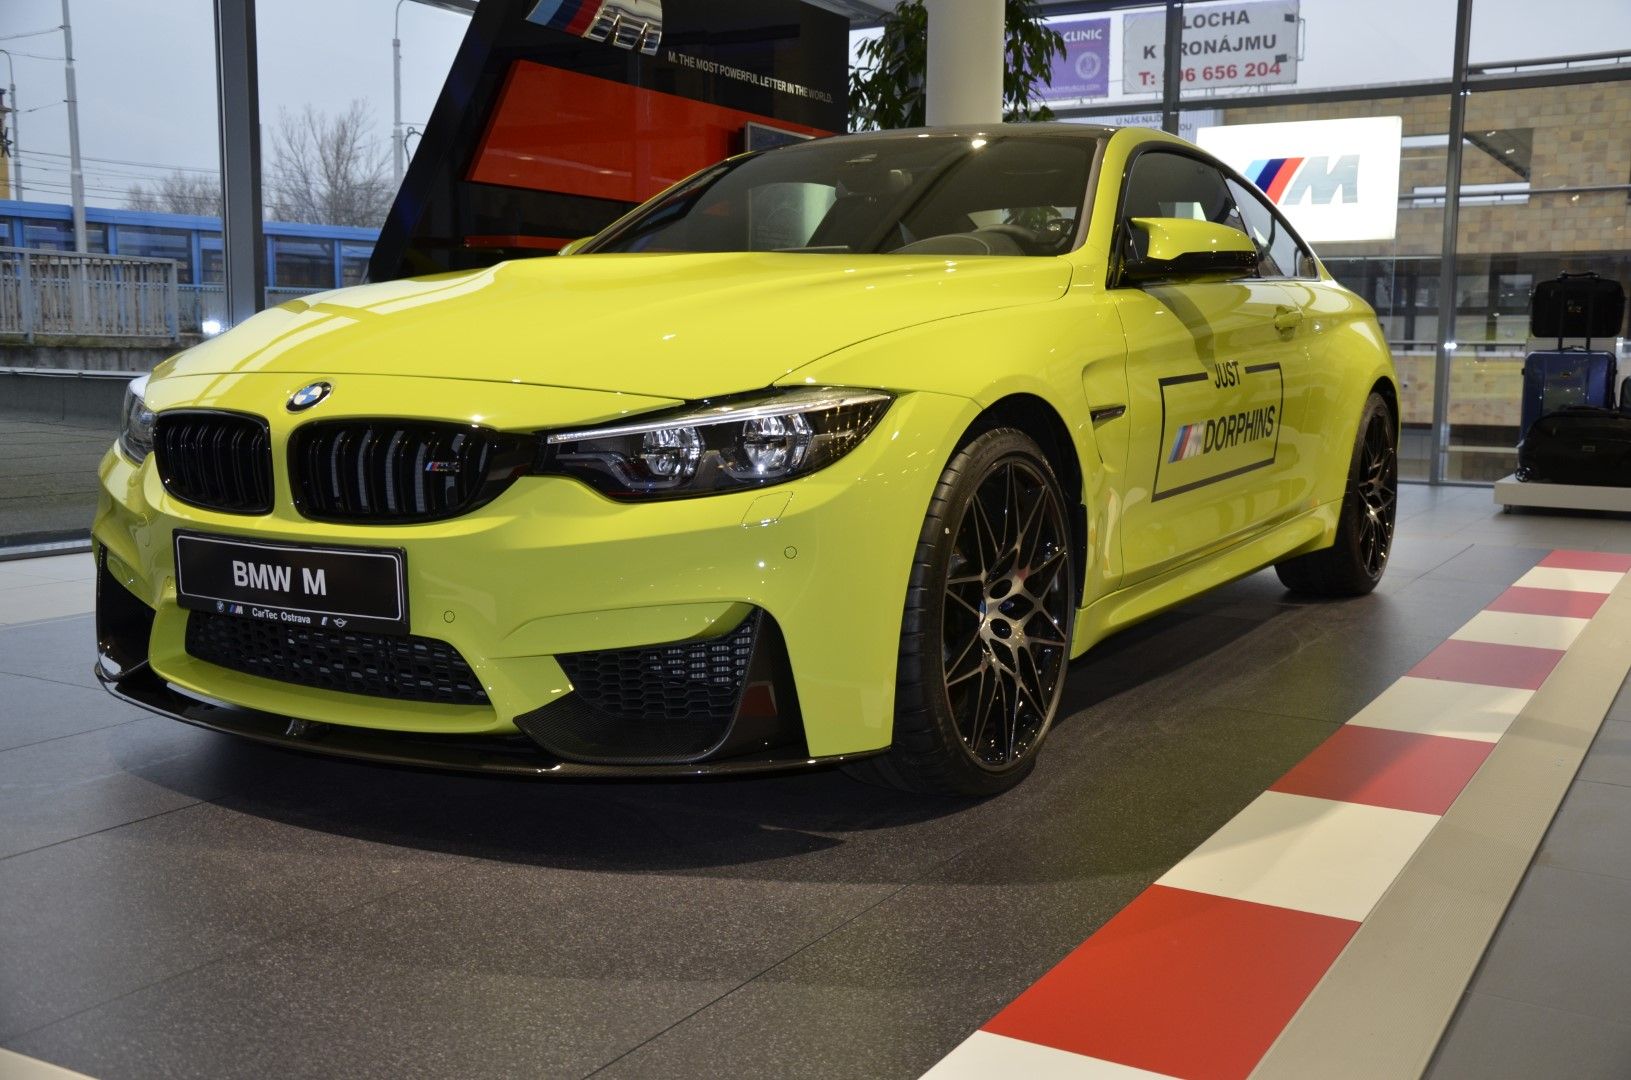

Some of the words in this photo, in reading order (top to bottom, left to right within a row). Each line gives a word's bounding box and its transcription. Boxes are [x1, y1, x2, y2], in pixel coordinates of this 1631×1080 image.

[1182, 10, 1250, 29] LOCHA
[1063, 28, 1103, 42] CLINIC
[1143, 45, 1156, 59] K
[1180, 34, 1277, 56] RONÁJMU
[668, 50, 678, 63] M.
[679, 53, 695, 68] THE
[696, 58, 719, 73] MOST
[719, 64, 759, 84] POWERFUL
[760, 75, 787, 92] LETTER
[786, 82, 795, 94] IN
[795, 84, 809, 97] THE
[808, 88, 833, 103] WORLD.
[1139, 71, 1155, 86] T:
[1202, 64, 1238, 81] 656
[1244, 62, 1282, 78] 204
[1214, 361, 1240, 389] JUST
[232, 560, 292, 593] BMW
[302, 567, 327, 596] M
[251, 607, 278, 620] CarTec
[280, 611, 311, 624] Ostrava
